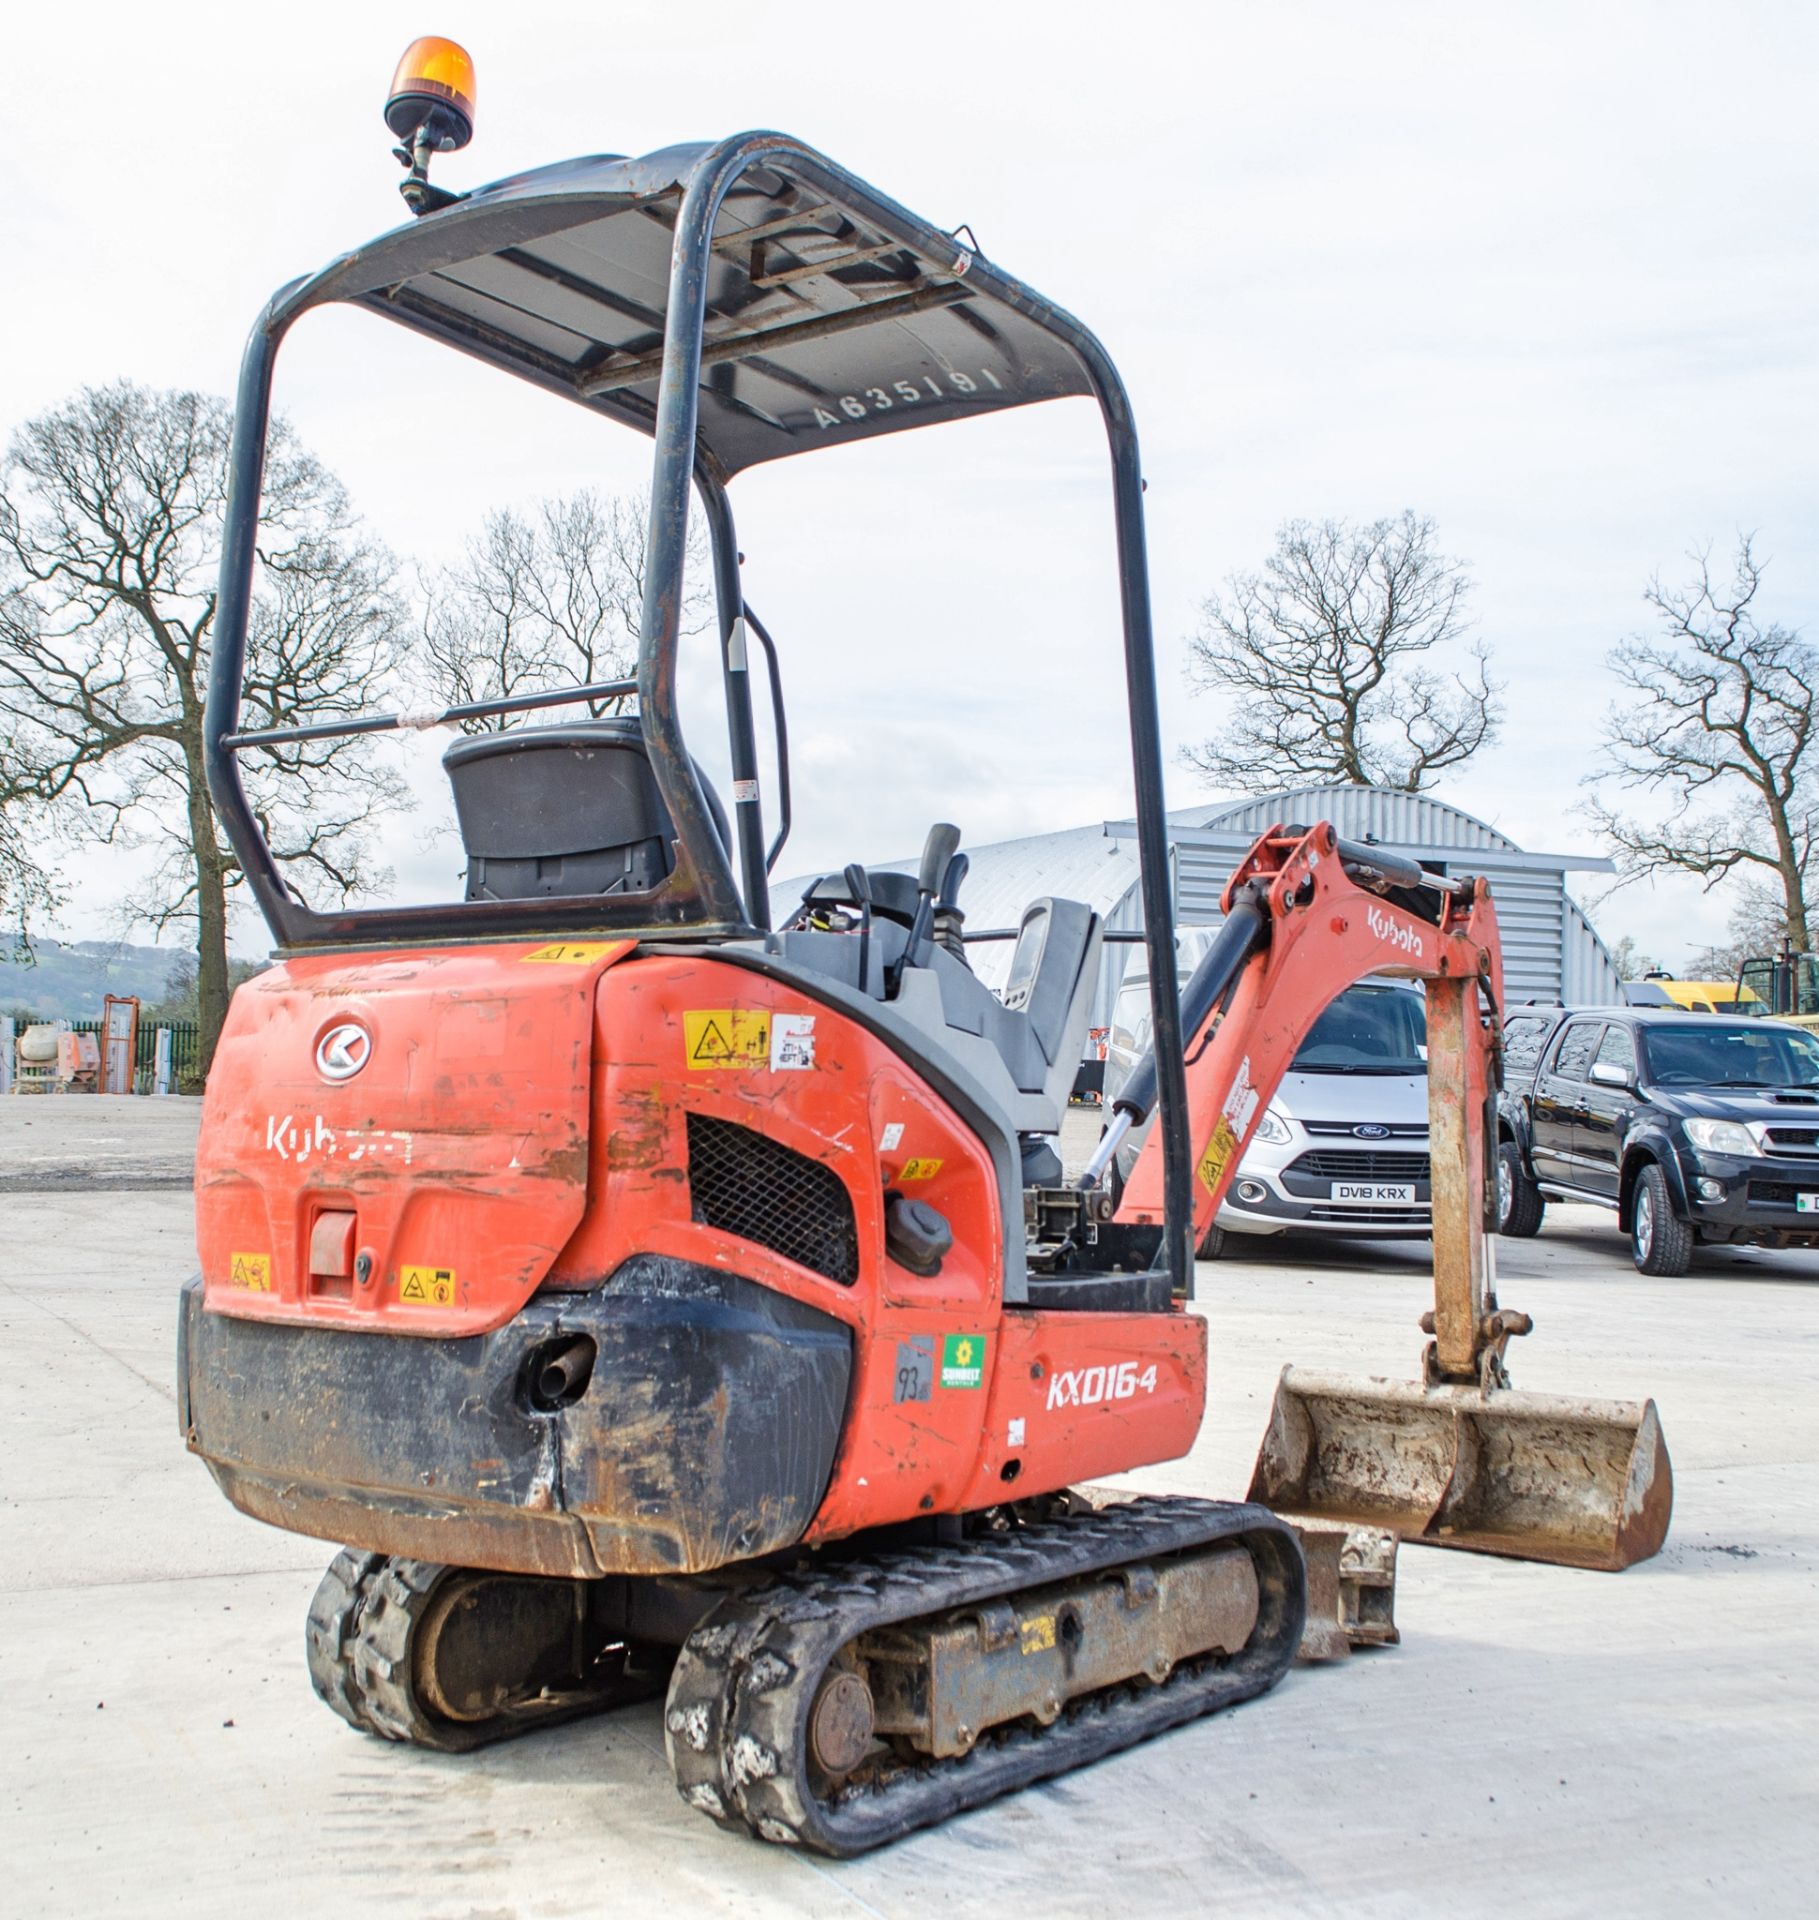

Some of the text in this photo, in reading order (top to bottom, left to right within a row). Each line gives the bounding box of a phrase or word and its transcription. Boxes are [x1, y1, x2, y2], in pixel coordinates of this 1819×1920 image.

[812, 368, 1002, 430] A635191
[1367, 904, 1423, 958] Kubota
[1361, 1126, 1382, 1136] Ford
[1340, 1187, 1407, 1200] DV18 KRX
